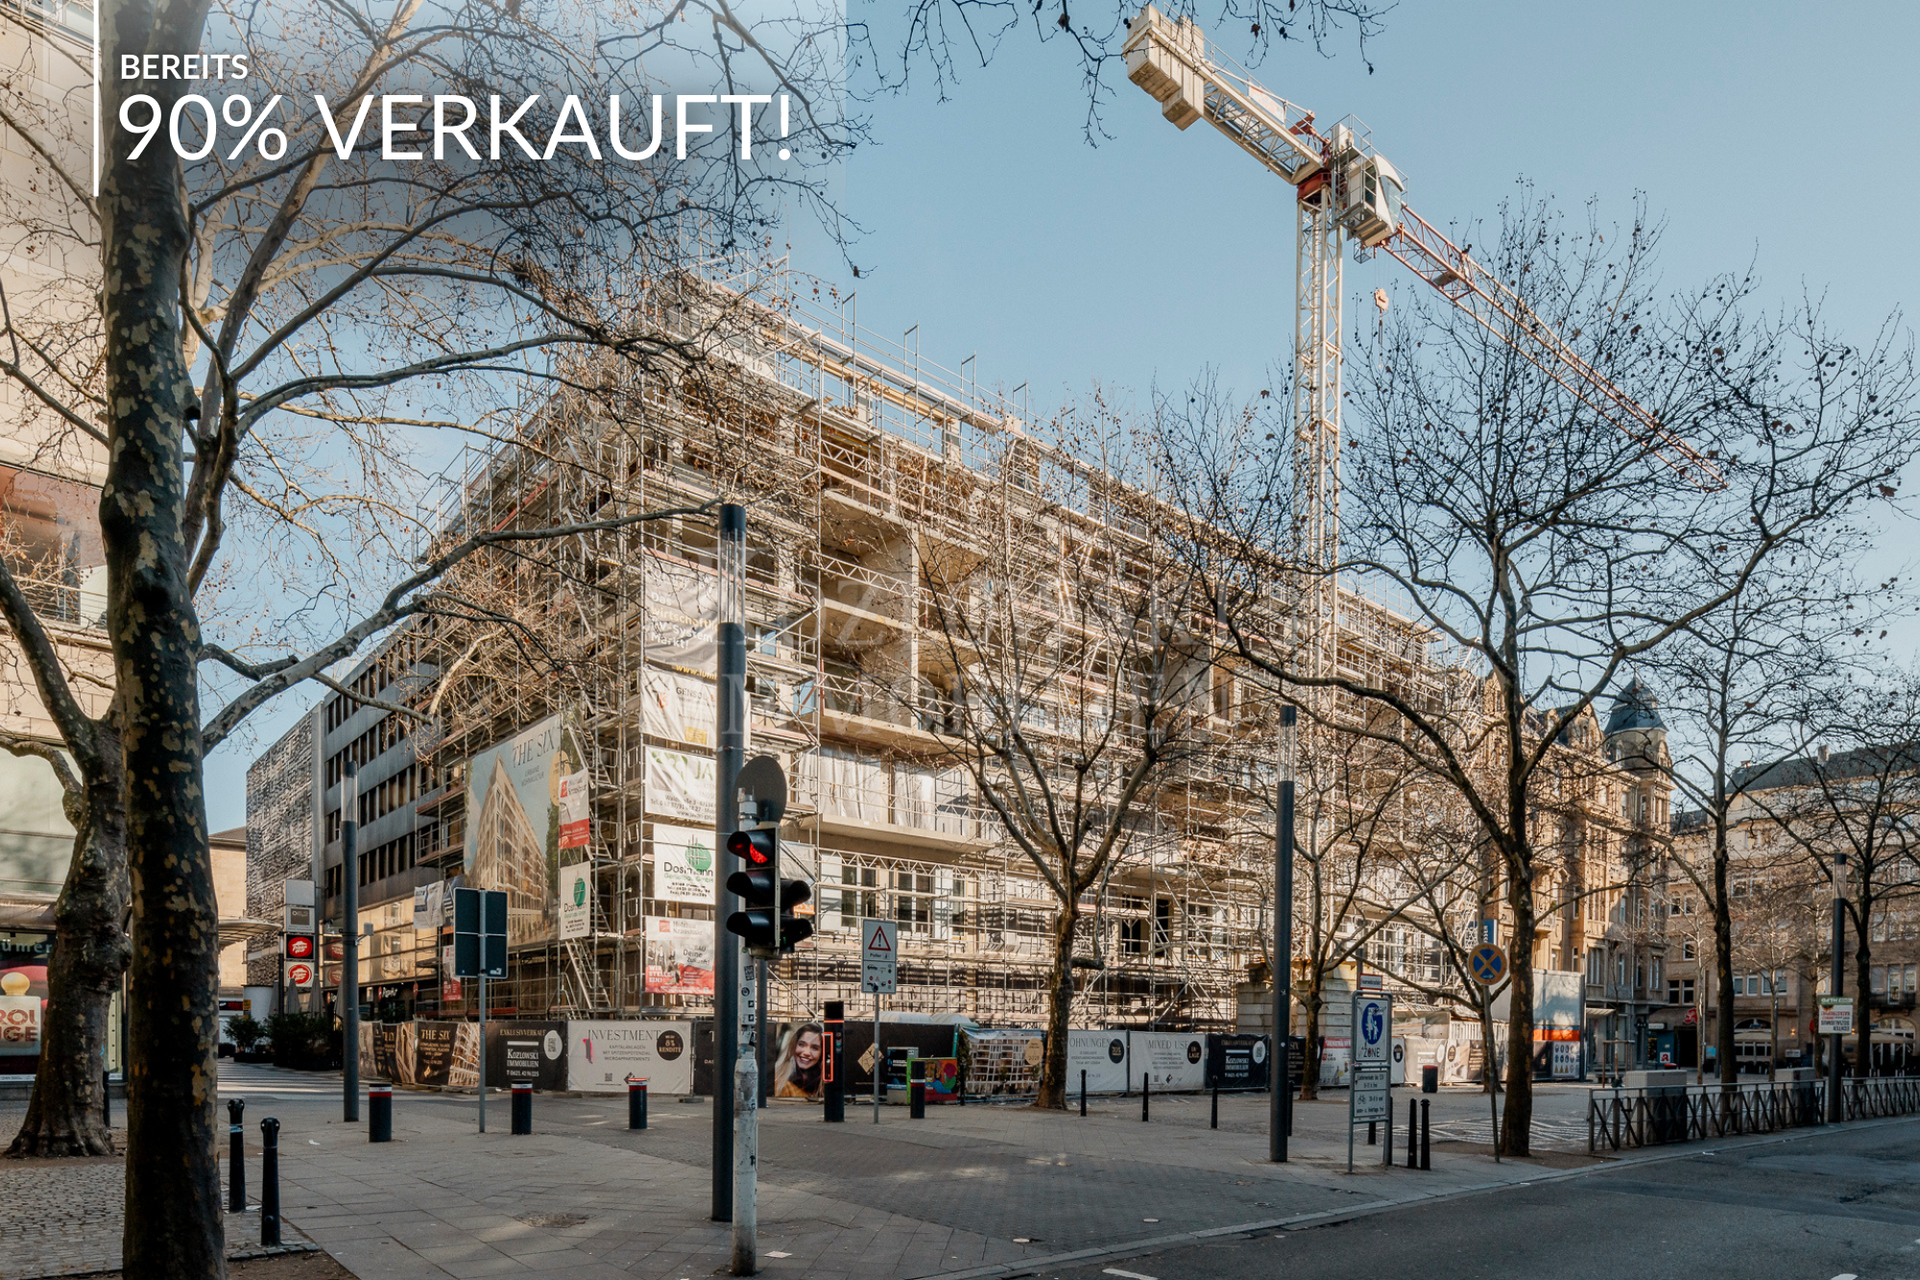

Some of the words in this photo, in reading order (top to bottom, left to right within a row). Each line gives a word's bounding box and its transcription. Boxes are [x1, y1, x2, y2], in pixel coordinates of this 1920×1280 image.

[651, 591, 672, 606] Das
[512, 738, 533, 769] THE
[537, 726, 555, 758] SIX
[421, 1029, 436, 1040] THE
[438, 1030, 450, 1040] SIX
[588, 1029, 661, 1041] INVESTMENT
[1148, 1040, 1171, 1049] MIXED
[1363, 1047, 1380, 1058] ZONE
